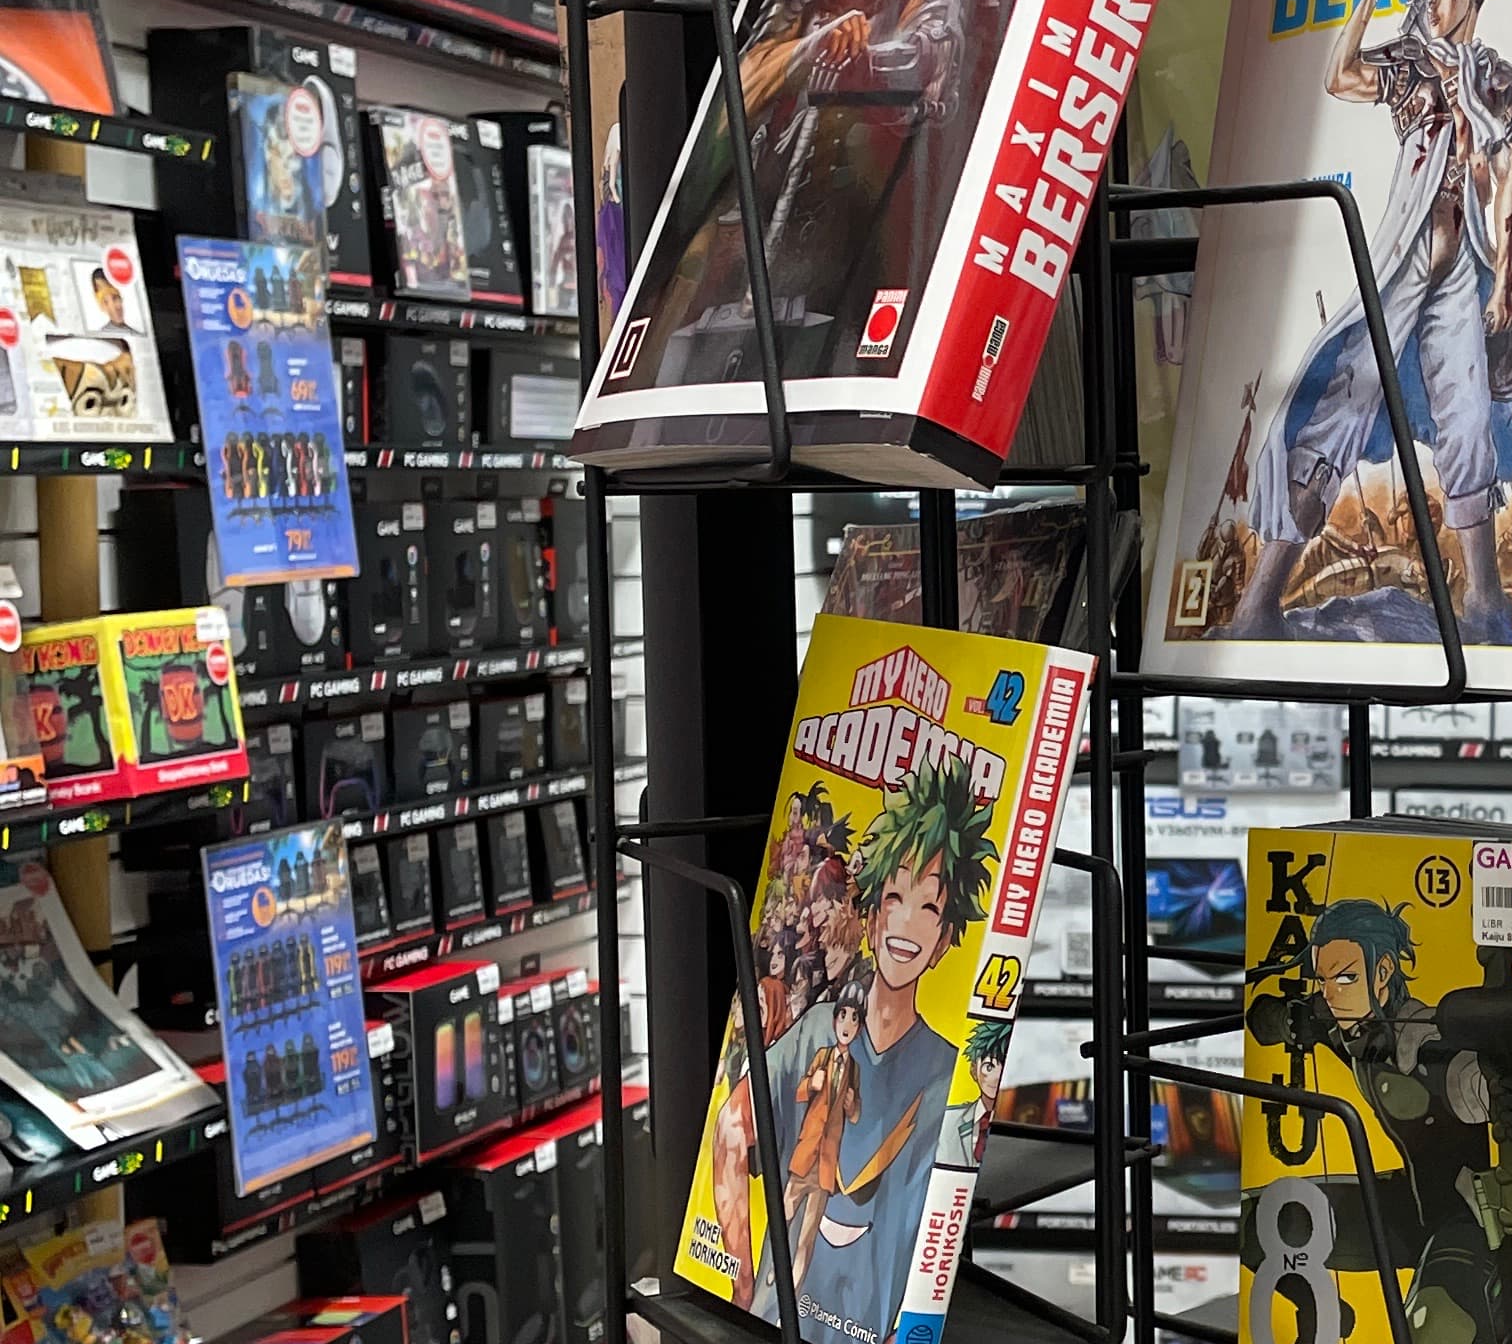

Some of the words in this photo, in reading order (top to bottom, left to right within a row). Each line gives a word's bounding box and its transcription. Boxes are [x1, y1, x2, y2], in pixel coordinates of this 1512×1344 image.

[851, 650, 906, 706] MY
[902, 649, 948, 721] HERO
[986, 670, 1025, 726] 42
[1029, 677, 1078, 803] ACADEMIA
[1395, 744, 1442, 759] GAMING
[1145, 797, 1227, 820] SUS
[1011, 808, 1048, 879] HERO
[1000, 885, 1028, 929] MY
[1481, 931, 1505, 944] Kaiju
[975, 953, 1023, 1011] 42
[693, 1216, 724, 1246] KOHEI
[918, 1211, 947, 1275] KOHEI
[931, 1186, 969, 1302] HORIKOSHI
[688, 1236, 742, 1280] HORIKOSHI
[809, 1300, 842, 1331] Planeta
